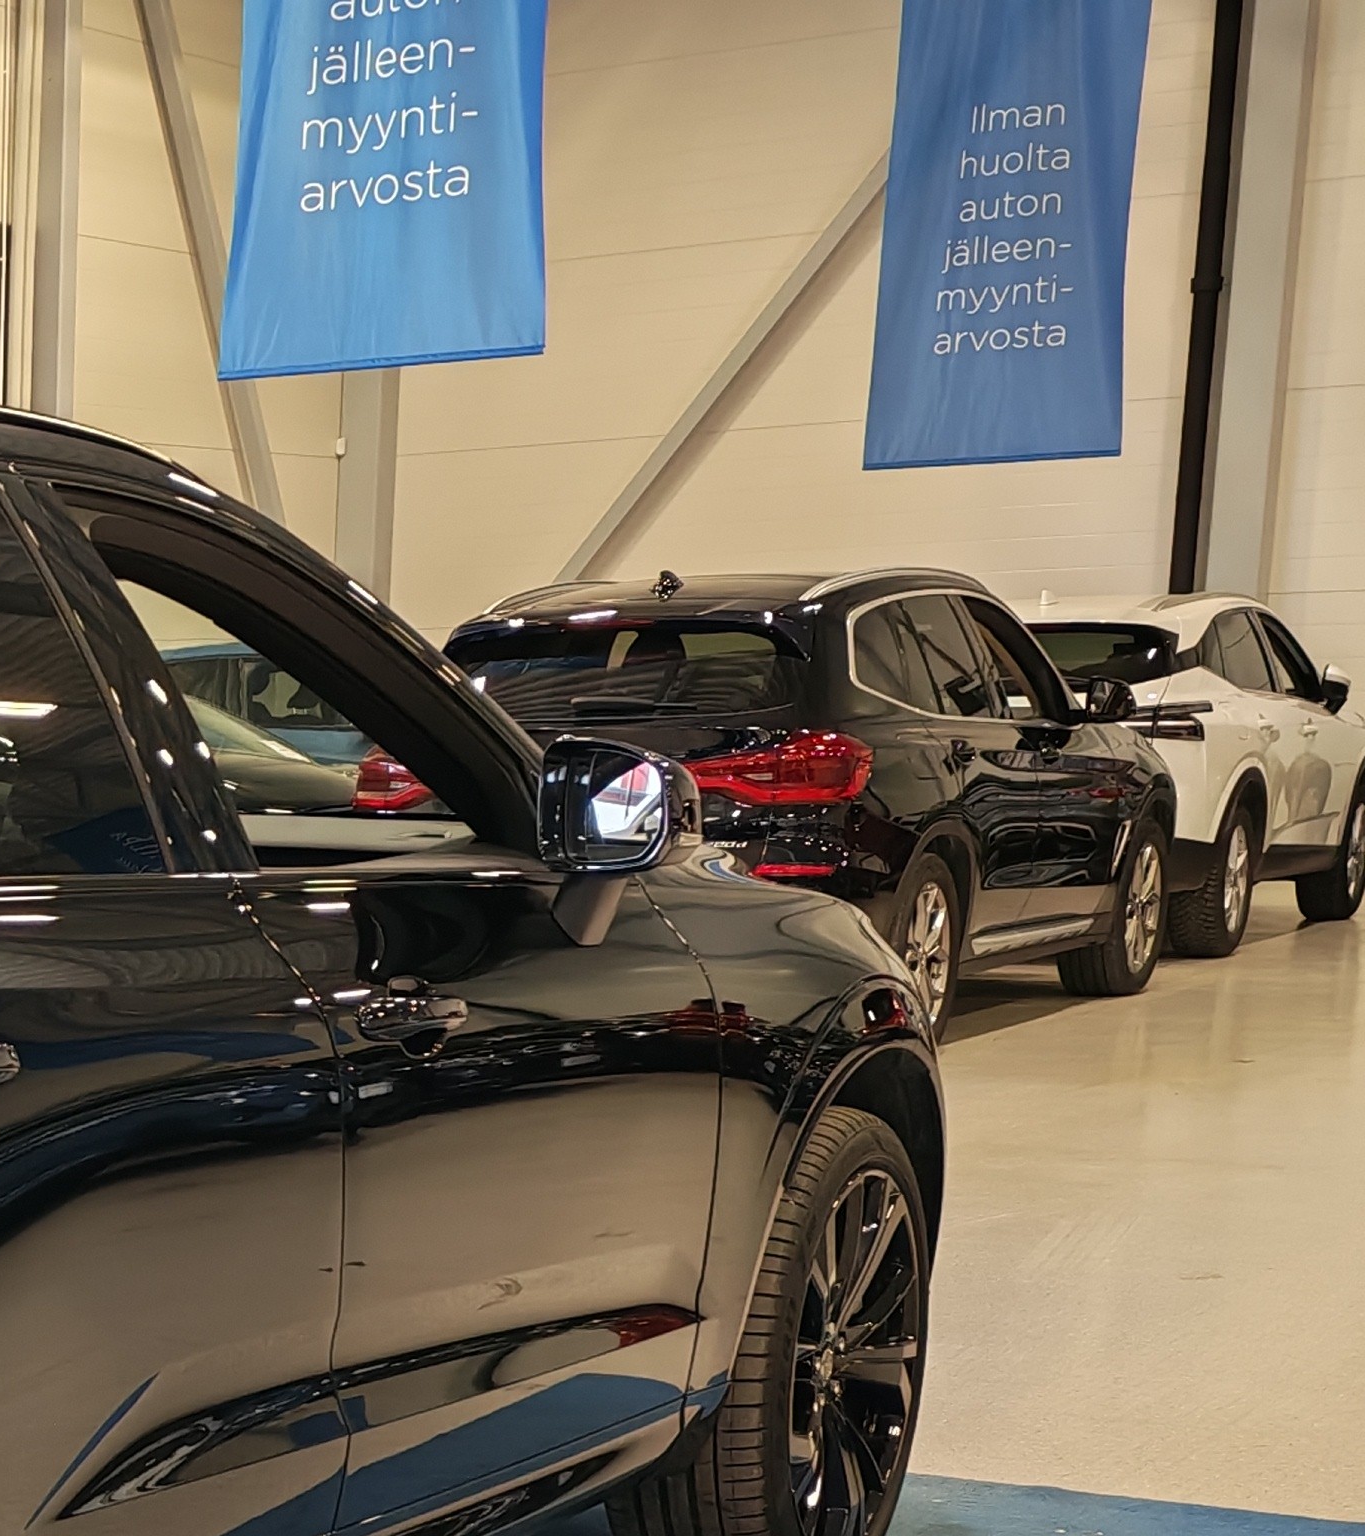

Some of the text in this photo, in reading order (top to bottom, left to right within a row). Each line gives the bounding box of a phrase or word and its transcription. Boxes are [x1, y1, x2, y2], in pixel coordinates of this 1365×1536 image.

[306, 38, 476, 95] jälleen-
[302, 91, 478, 154] myynti-
[971, 103, 1066, 134] Ilman
[960, 142, 1070, 179] huolta
[300, 160, 469, 212] arvosta
[959, 191, 1062, 223] auton
[941, 234, 1072, 274] jälleen-
[936, 274, 1074, 315] myynti-
[933, 320, 1067, 355] arvosta
